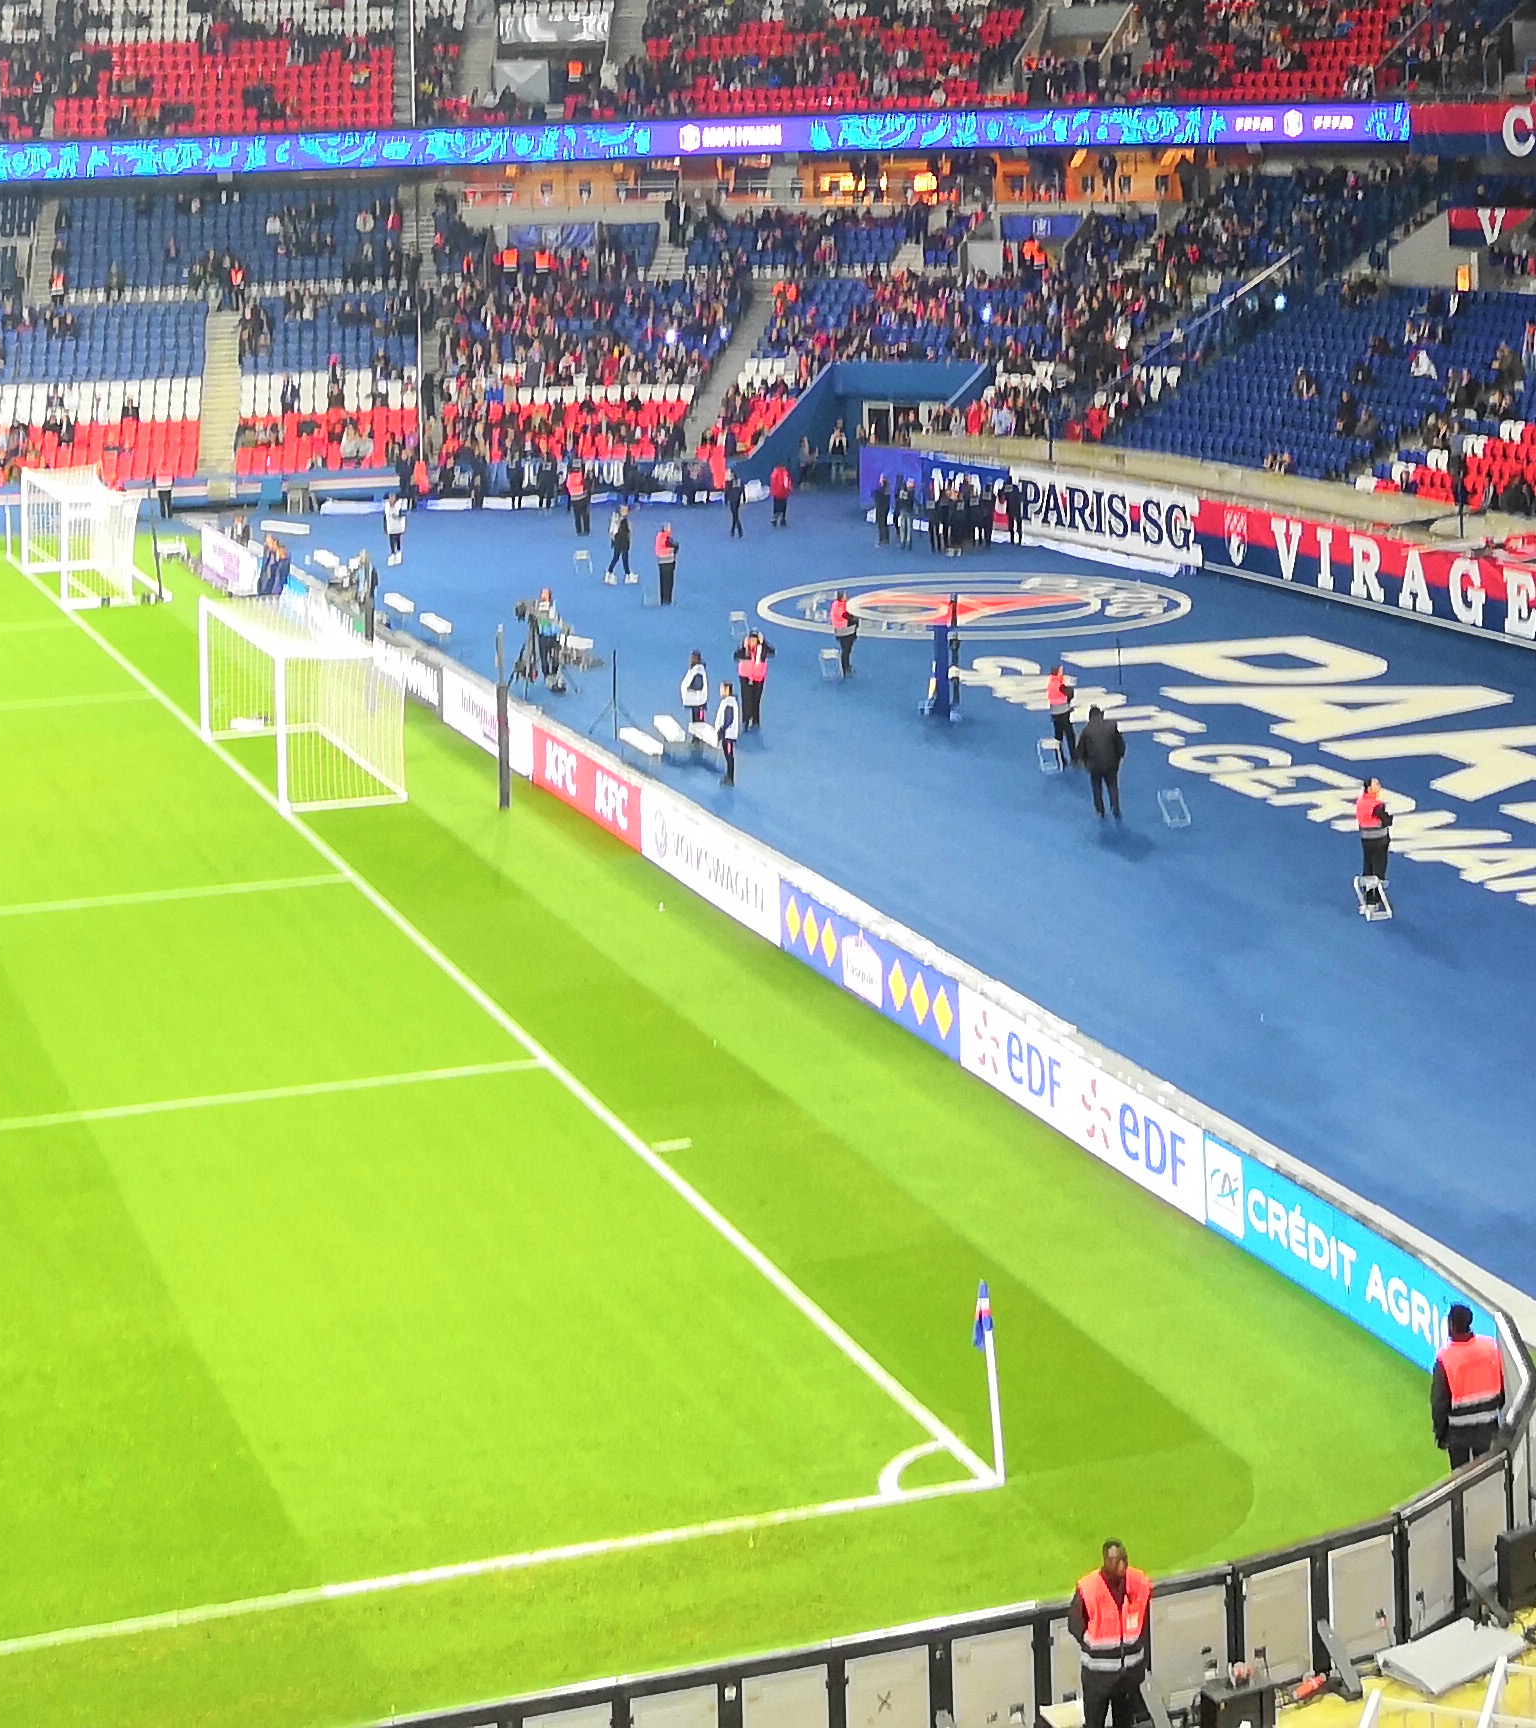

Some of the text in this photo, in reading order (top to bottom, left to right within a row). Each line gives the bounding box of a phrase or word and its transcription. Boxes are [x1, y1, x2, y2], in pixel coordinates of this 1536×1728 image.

[1476, 206, 1507, 246] V
[1018, 478, 1130, 540] PARIS
[1141, 499, 1193, 551] SG
[544, 738, 630, 832] KFC KFC
[672, 830, 765, 914] VOLKSWAGEN
[1246, 1187, 1358, 1288] CRÉDIT
